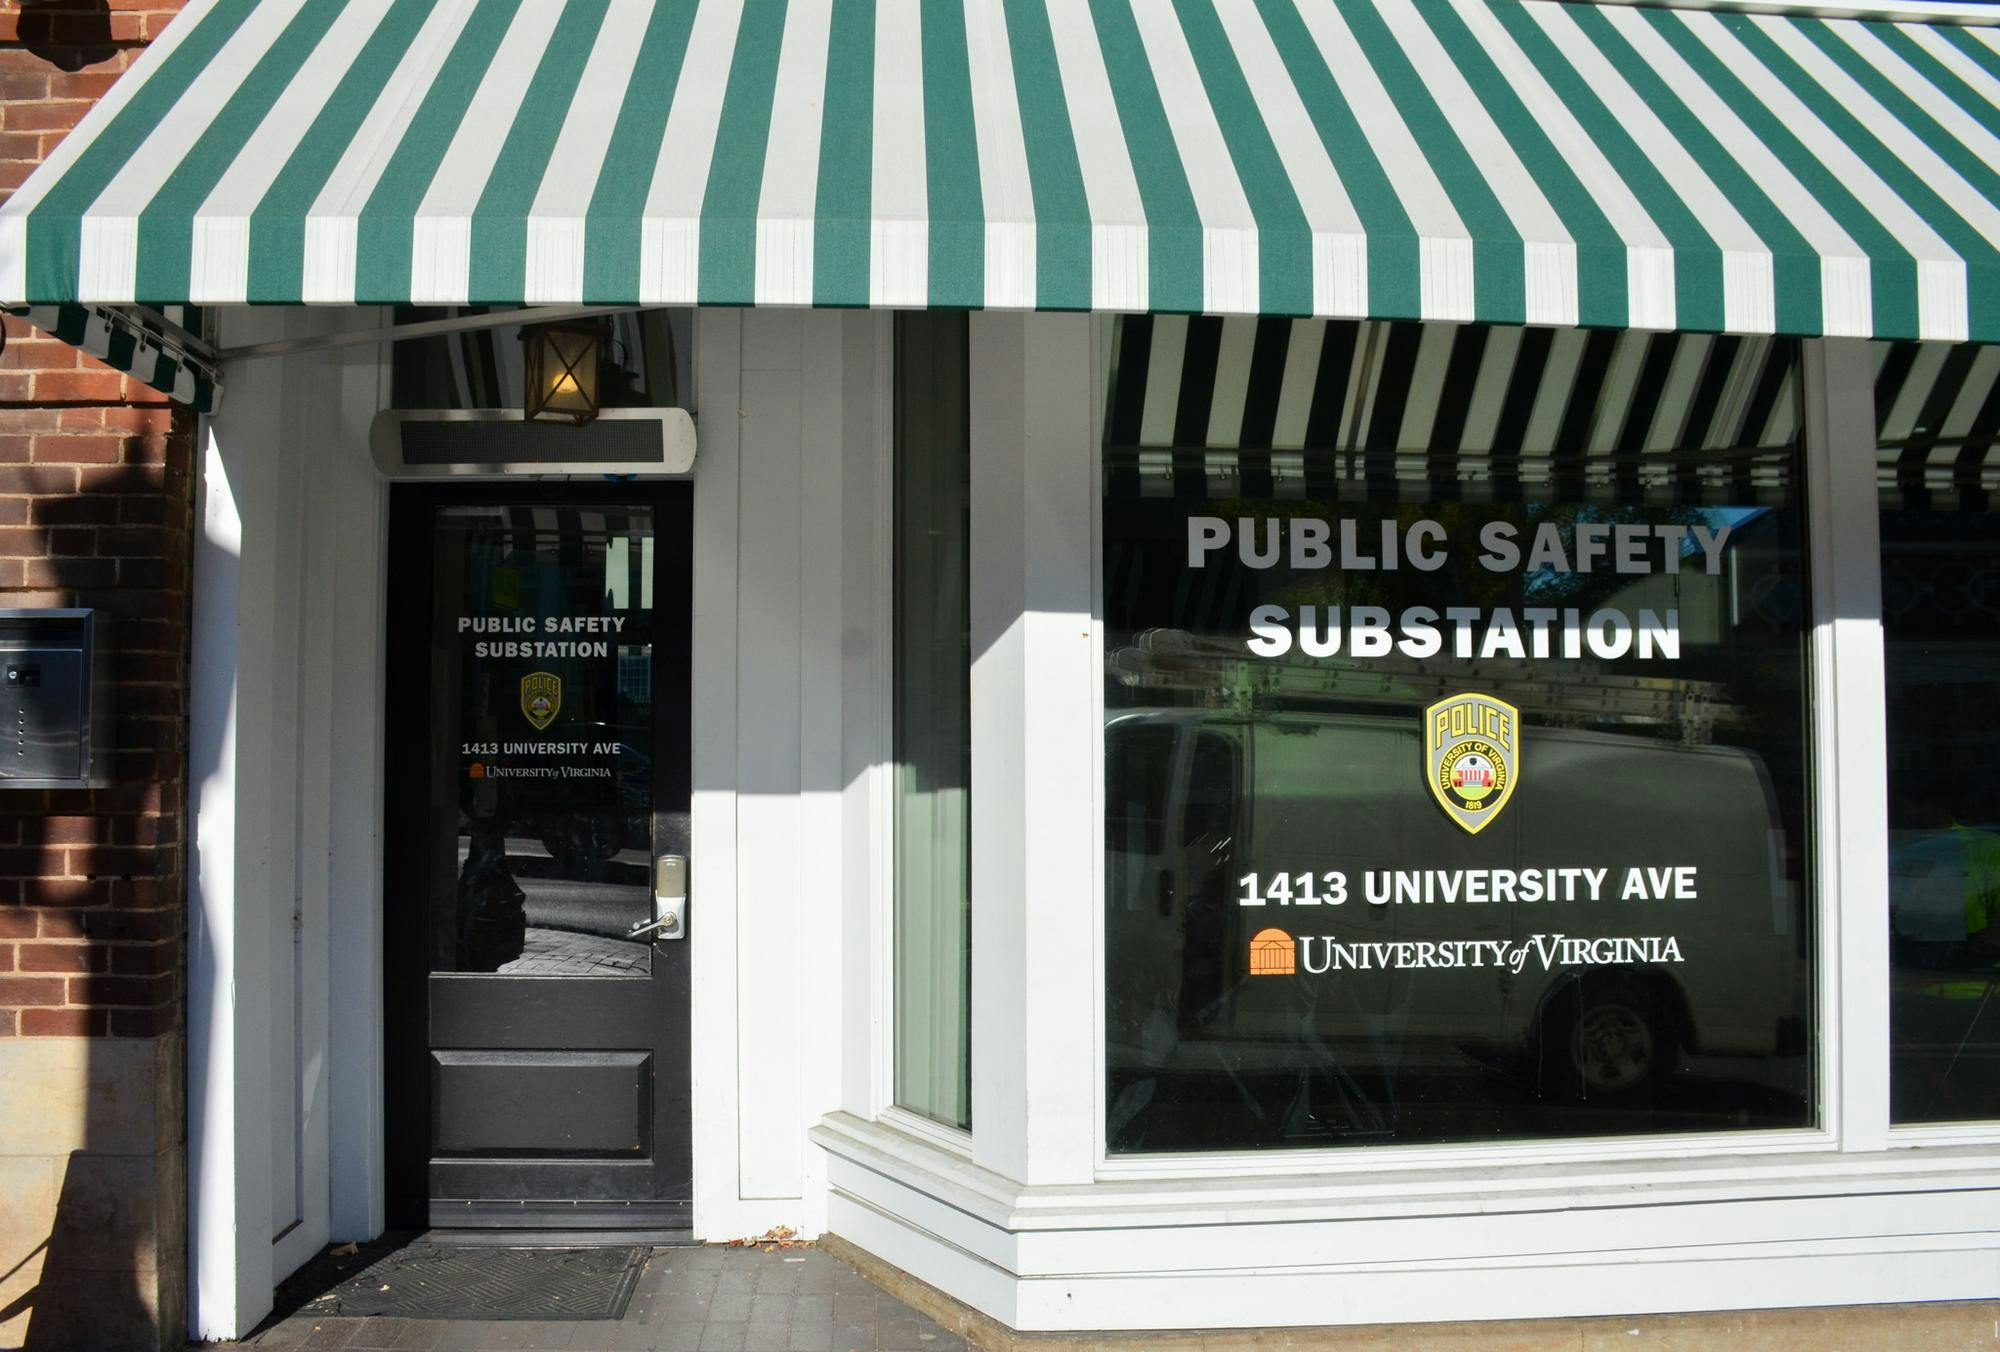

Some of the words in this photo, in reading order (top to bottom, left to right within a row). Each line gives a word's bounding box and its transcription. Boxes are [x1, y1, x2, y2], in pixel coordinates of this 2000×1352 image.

[1187, 517, 1447, 570] PUBLIC
[1479, 522, 1730, 575] SAFETY
[458, 617, 536, 633] PUBLIC
[544, 617, 626, 633] SAFETY
[1247, 605, 1681, 659] SUBSTATION
[475, 641, 608, 658] SUBSTATION
[525, 675, 558, 696] POLICE
[1435, 702, 1511, 752] POLICE
[461, 743, 498, 755] 1413
[503, 743, 587, 755] UNIVERSITY
[593, 743, 621, 755] AVE
[486, 765, 552, 778] UNIVERSITY
[560, 766, 611, 778] VIRGINIA
[1441, 742, 1472, 789] UNIVERSITY
[1474, 743, 1488, 752] OF
[1488, 748, 1507, 790] VIRGINIA
[1465, 801, 1482, 809] 1819
[1238, 872, 1347, 906] 1413
[1364, 868, 1607, 904] UNIVERSITY
[1621, 866, 1697, 900] AVE
[1299, 936, 1511, 974] UNIVERSITY
[1509, 940, 1533, 974] of
[1532, 934, 1685, 971] VIRGINIA
